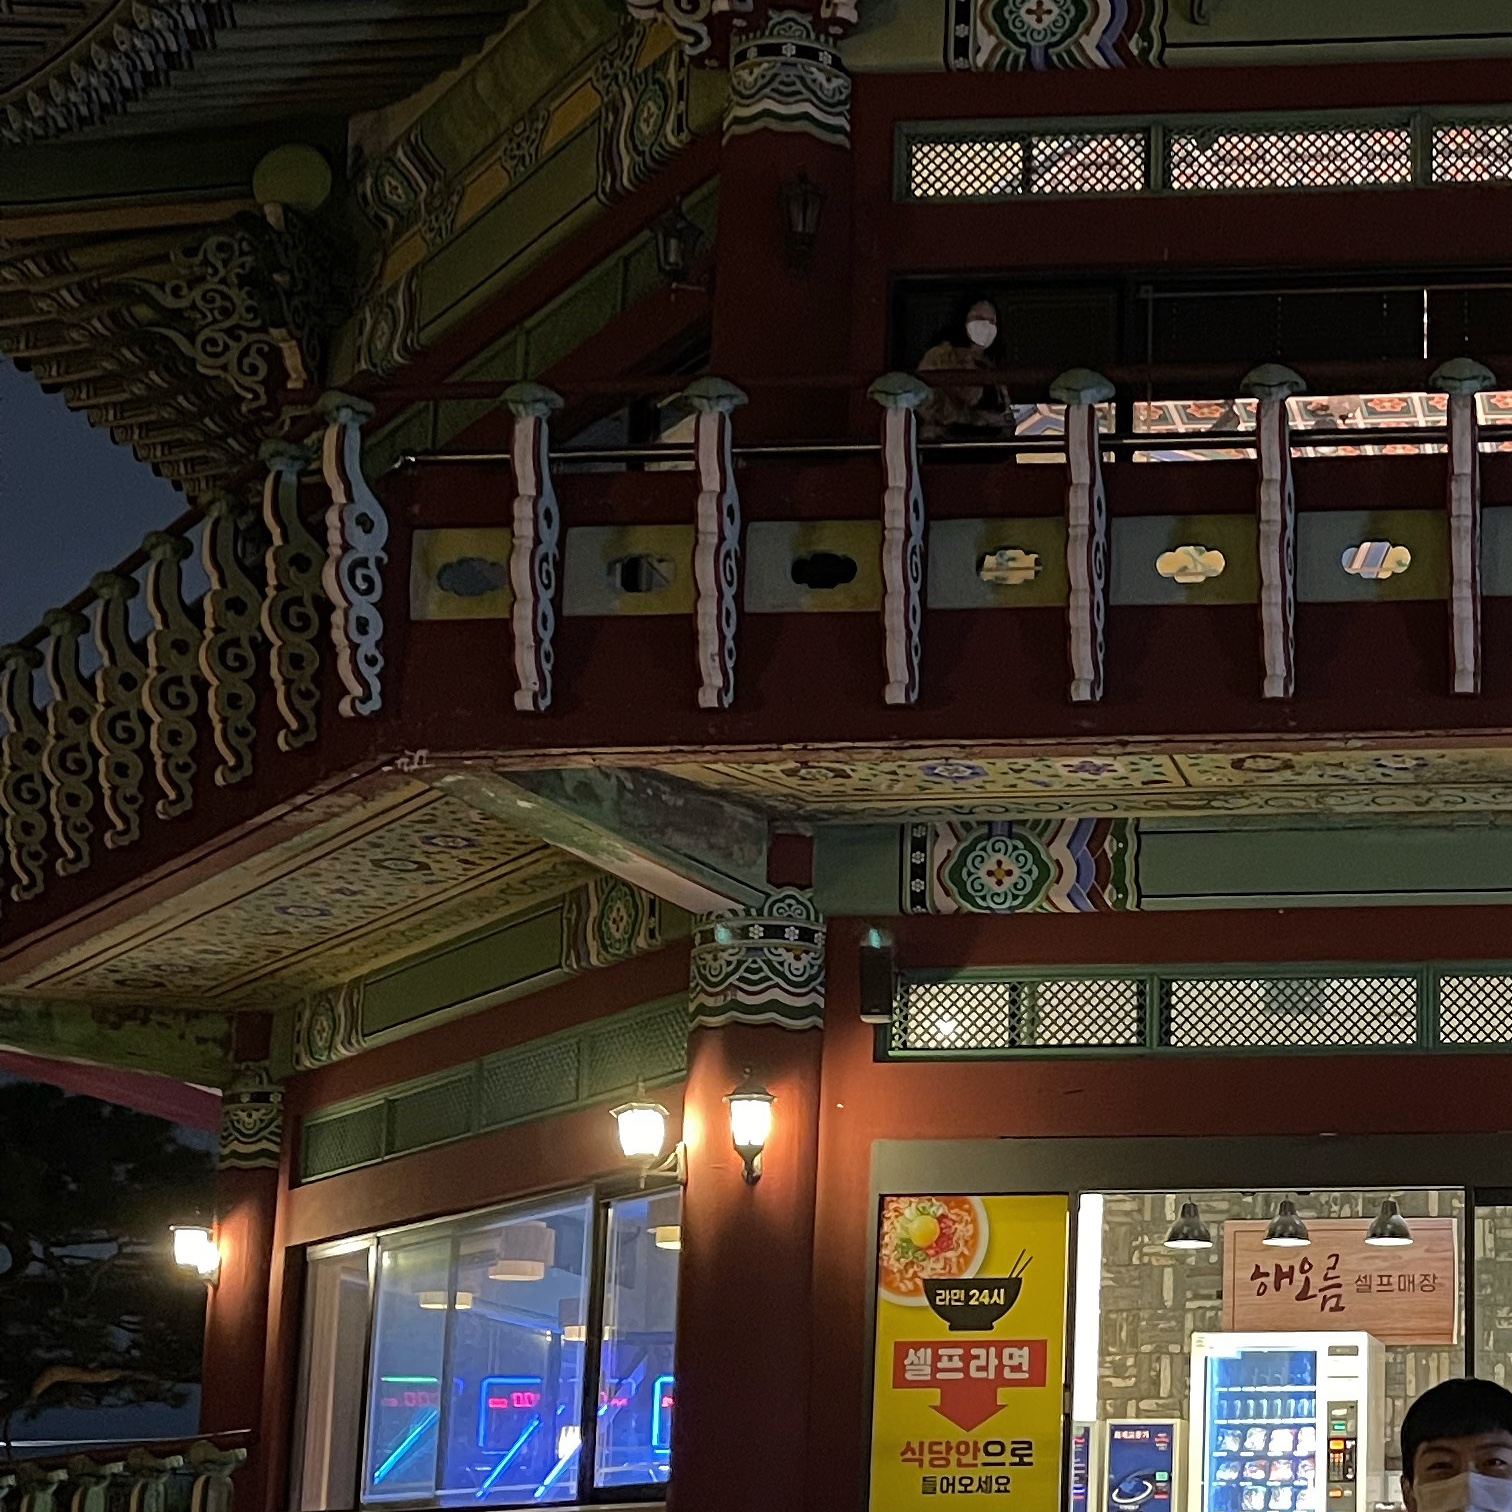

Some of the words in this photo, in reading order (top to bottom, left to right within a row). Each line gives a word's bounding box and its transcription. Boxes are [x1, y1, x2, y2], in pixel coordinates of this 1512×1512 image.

[935, 1289, 965, 1307] 라면
[968, 1287, 1006, 1307] 24시
[1250, 1253, 1345, 1312] 해오름
[1354, 1273, 1439, 1294] 셀프매장
[904, 1346, 1030, 1381] 셀프라면
[900, 1440, 1034, 1469] 식당안으로
[921, 1475, 1011, 1495] 들어오세요
